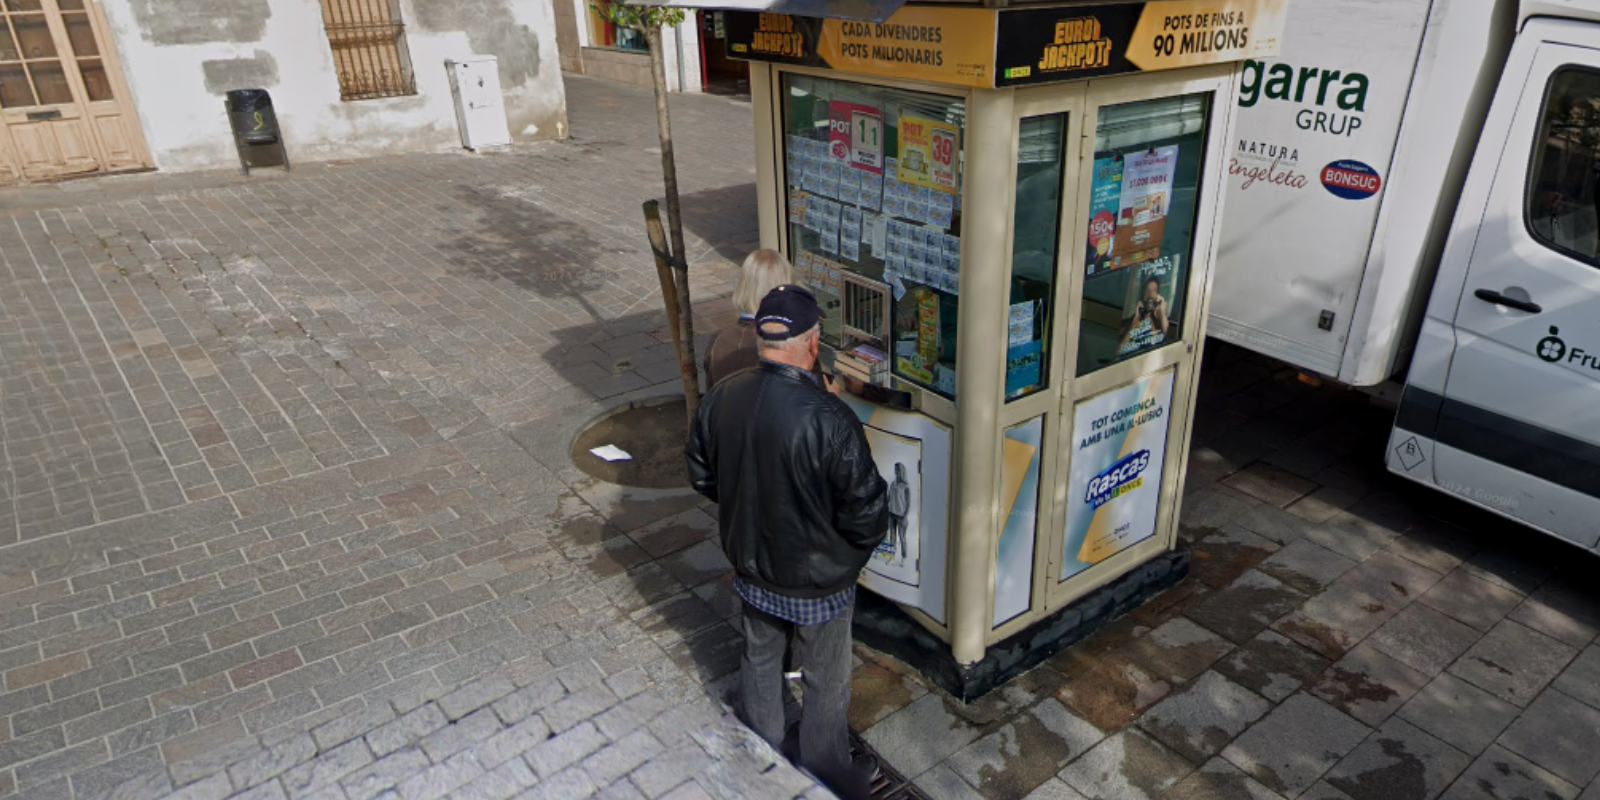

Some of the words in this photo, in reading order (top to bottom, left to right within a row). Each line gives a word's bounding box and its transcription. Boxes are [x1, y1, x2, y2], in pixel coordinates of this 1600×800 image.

[842, 22, 873, 39] CADA
[875, 23, 942, 43] DIVENDRES
[1164, 15, 1193, 31] POTS
[1195, 14, 1209, 28] DE
[1211, 12, 1234, 27] FINS
[1235, 11, 1244, 24] A
[1153, 34, 1175, 57] 90
[1180, 27, 1248, 54] MILIONS
[842, 43, 869, 59] POTS
[872, 45, 943, 66] MILIONARIS
[1038, 38, 1112, 72] JACKPOT
[1238, 59, 1369, 112] garra
[831, 119, 850, 135] POT
[1296, 109, 1362, 137] GRUP
[933, 135, 953, 166] 39
[1238, 139, 1299, 162] NATURA
[1325, 169, 1376, 189] BONSUC
[1091, 221, 1114, 235] 150€
[1568, 346, 1600, 371] Fru
[1091, 415, 1109, 431] TOT
[1080, 432, 1103, 450] AMB
[1104, 423, 1125, 439] UNA
[1086, 452, 1149, 502] Rascas
[1120, 478, 1142, 494] ONCE
